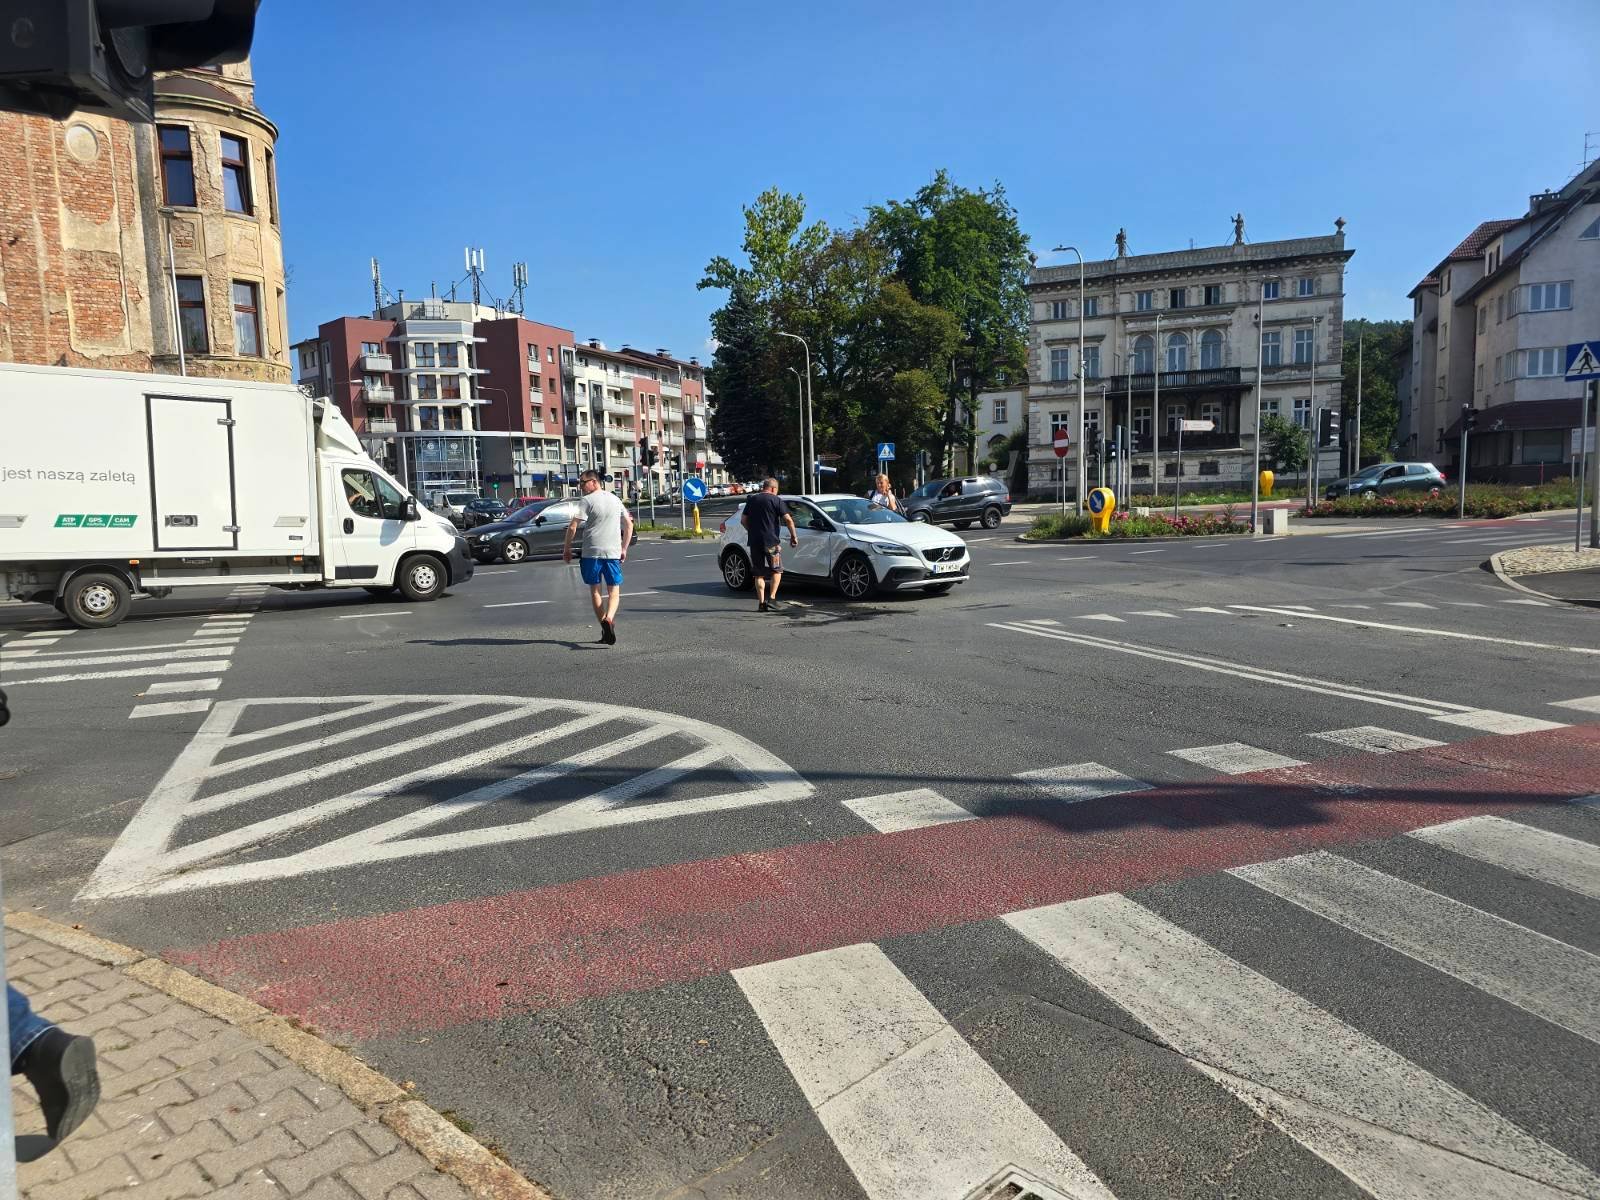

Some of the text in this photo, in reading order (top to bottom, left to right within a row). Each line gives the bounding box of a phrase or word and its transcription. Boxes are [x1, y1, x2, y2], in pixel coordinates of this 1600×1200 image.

[2, 467, 136, 485] jest naszą zaletą
